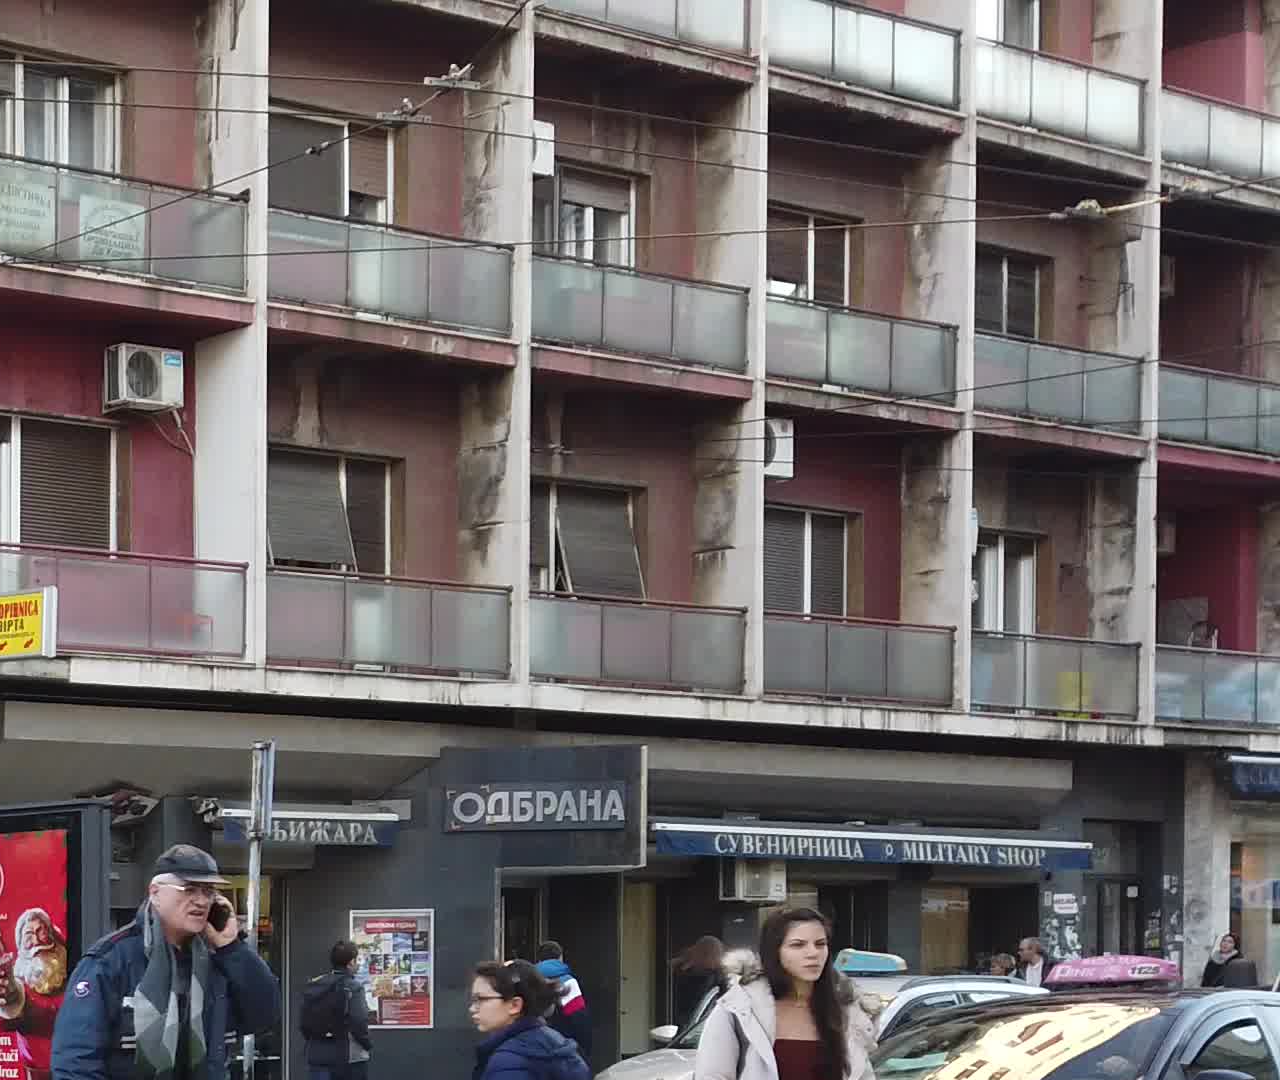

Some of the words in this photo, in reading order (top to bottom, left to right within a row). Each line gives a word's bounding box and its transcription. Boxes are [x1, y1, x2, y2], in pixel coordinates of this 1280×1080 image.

[452, 789, 626, 824] ОДБРАНА
[714, 833, 865, 860] СУВЕНИРНИЦА
[902, 841, 992, 864] MILITARY
[997, 847, 1046, 867] SHOP
